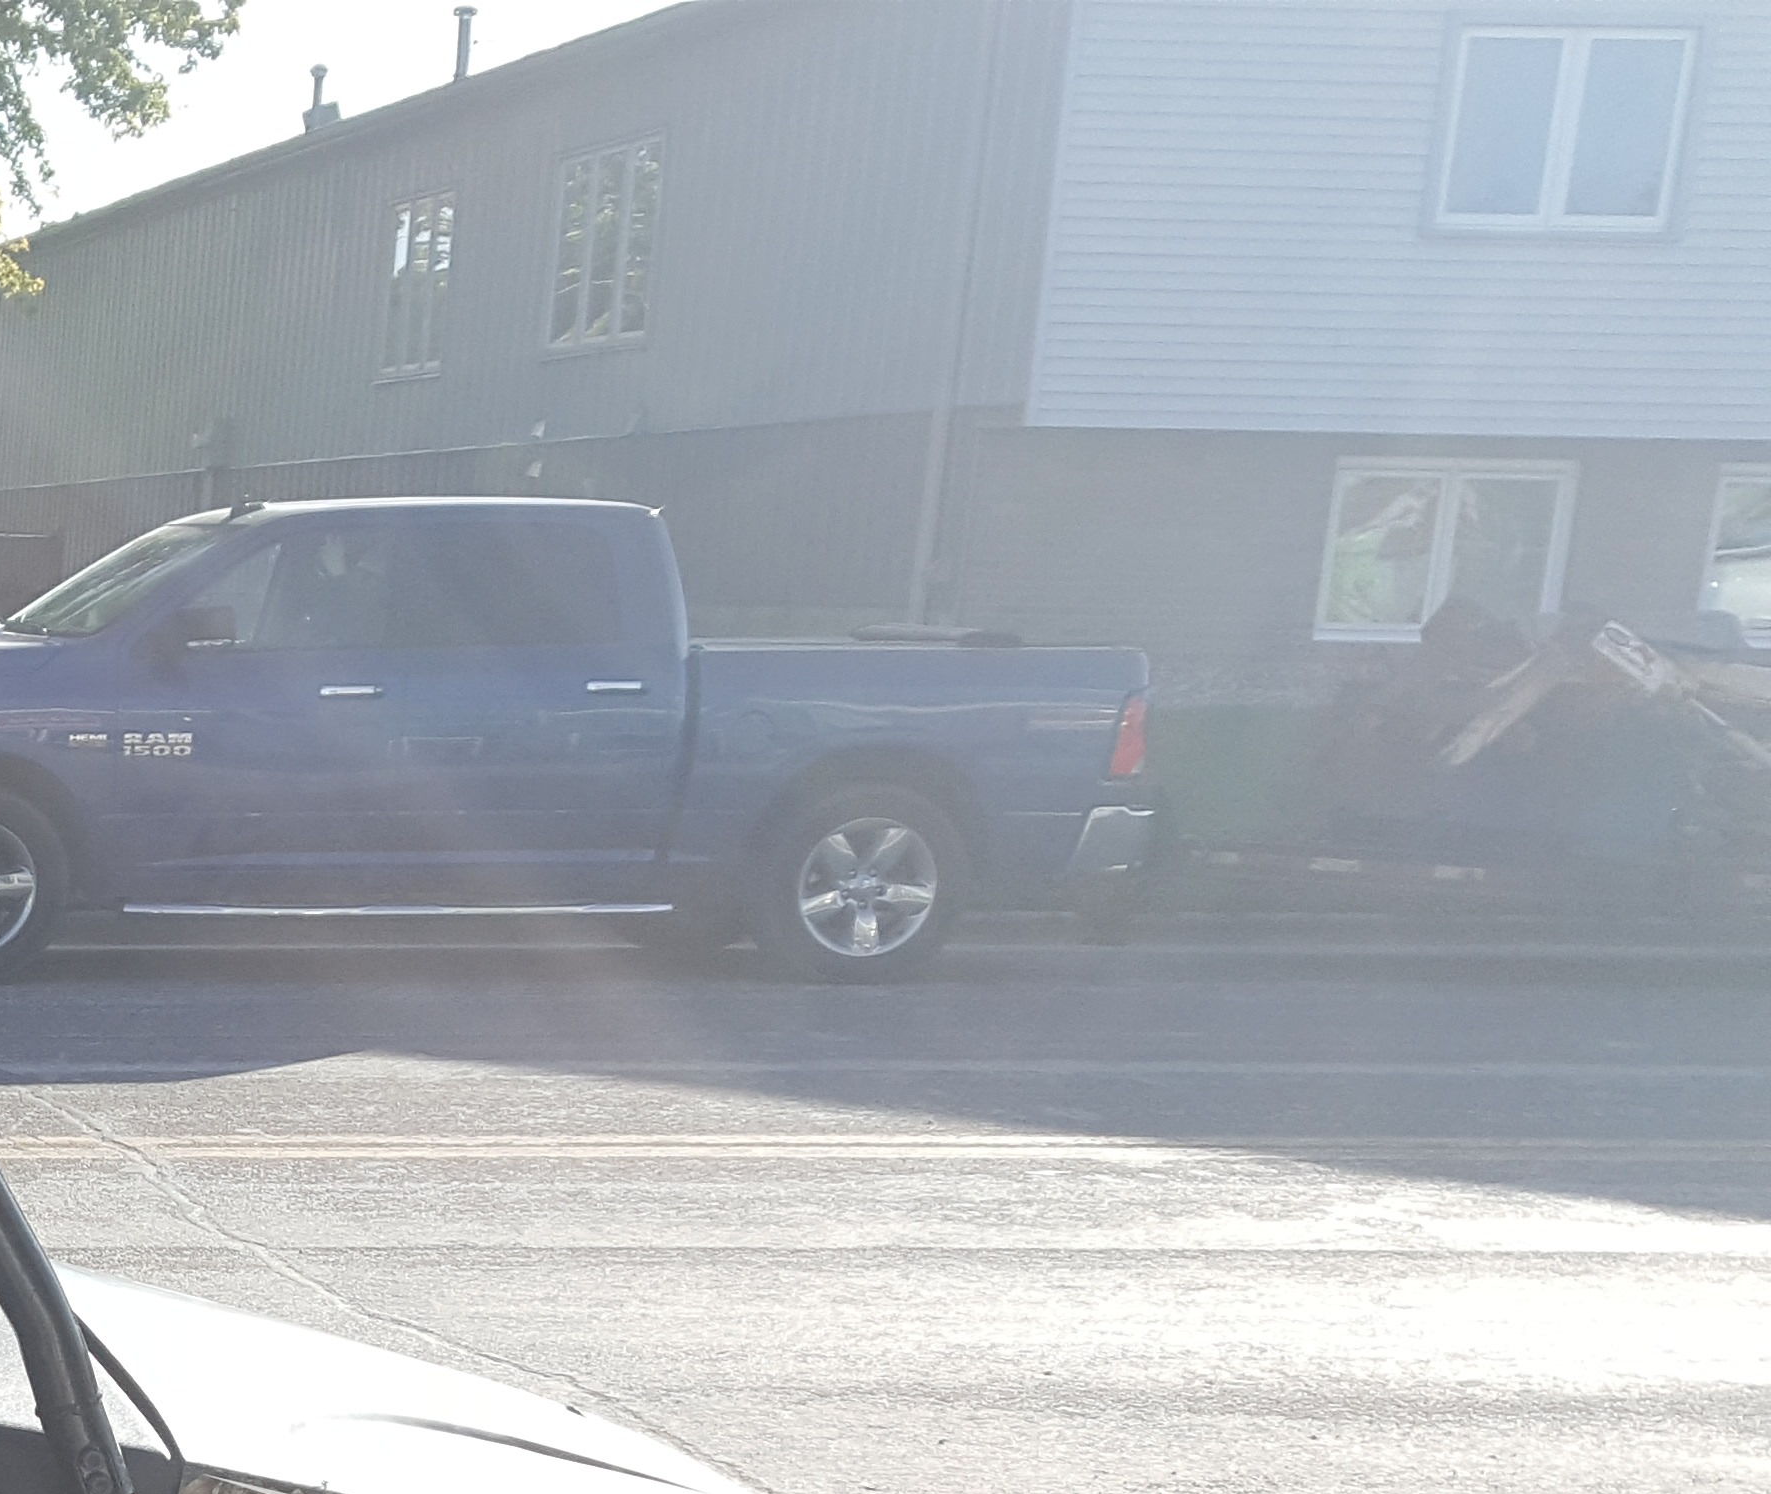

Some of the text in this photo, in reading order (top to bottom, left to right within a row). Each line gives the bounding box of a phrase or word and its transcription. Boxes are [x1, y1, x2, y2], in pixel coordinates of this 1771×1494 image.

[69, 733, 107, 741] HEMI
[123, 733, 192, 744] RAM
[123, 745, 191, 755] 1500
